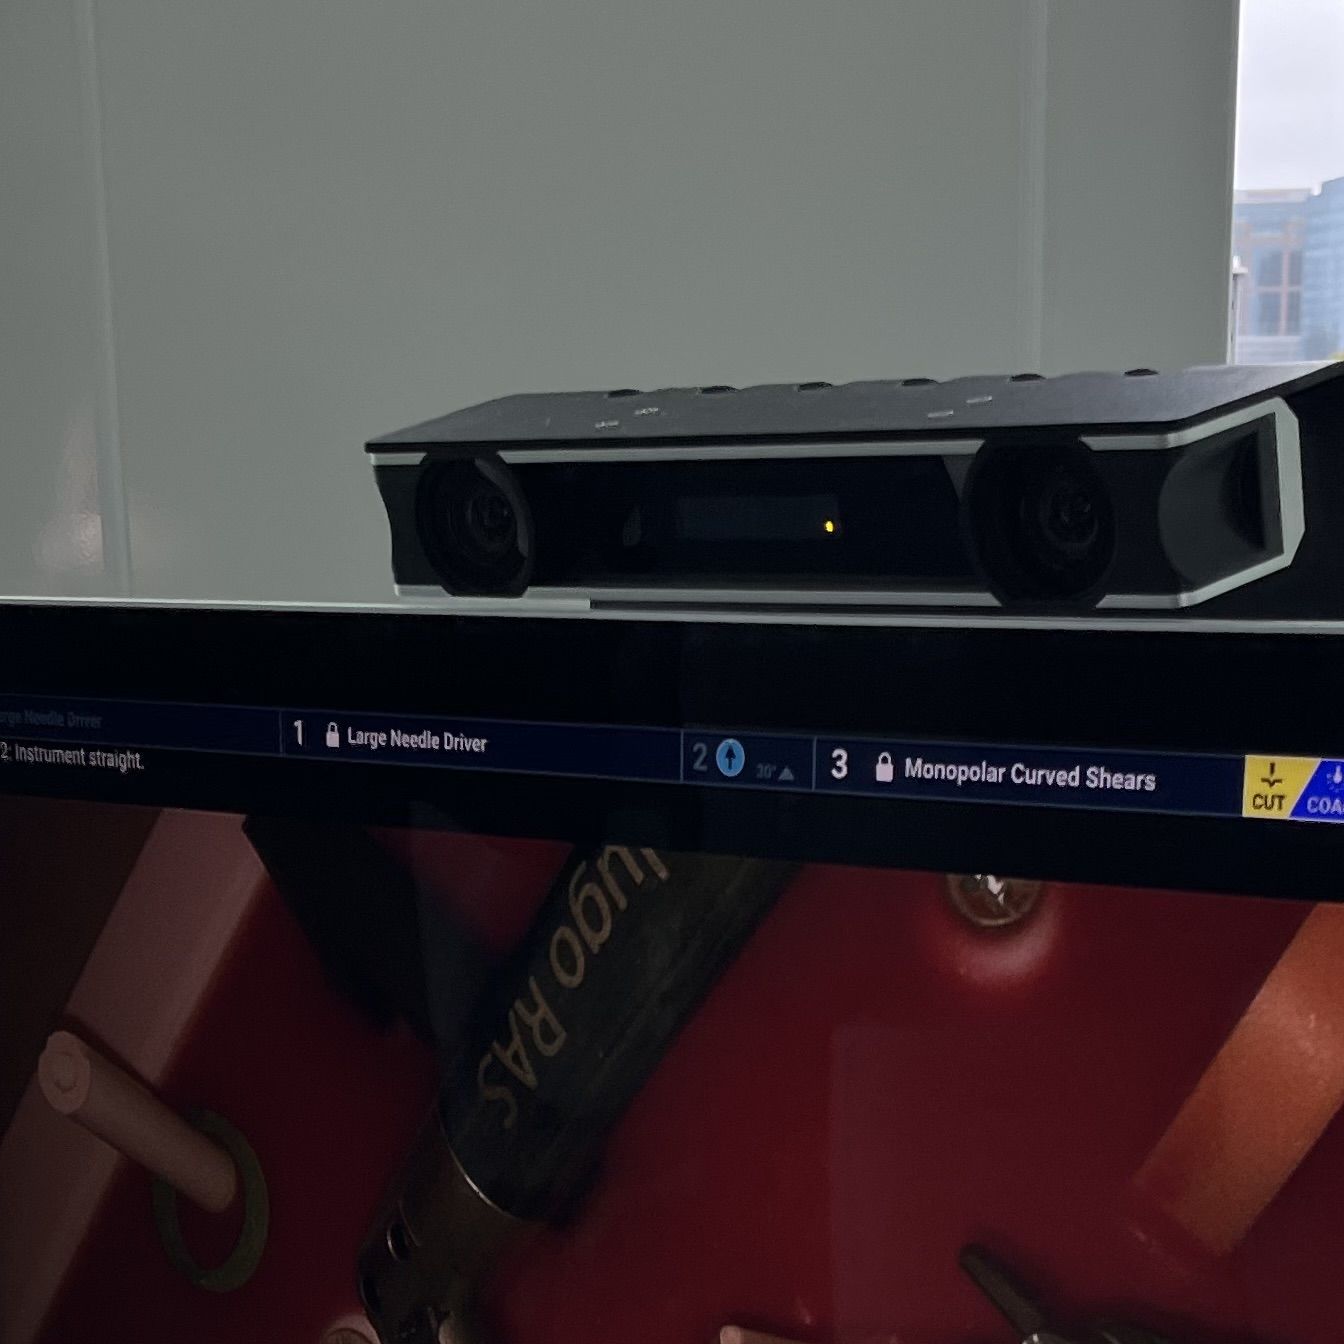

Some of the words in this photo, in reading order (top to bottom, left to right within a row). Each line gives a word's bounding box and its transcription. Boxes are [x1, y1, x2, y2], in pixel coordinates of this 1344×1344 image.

[293, 719, 303, 747] 1
[347, 726, 387, 750] Large
[390, 728, 440, 750] Needle
[443, 731, 488, 753] Driver
[15, 743, 87, 767] Instrument
[88, 748, 145, 775] straight.
[692, 742, 708, 771] 2
[831, 748, 849, 780] 3
[905, 757, 1007, 786] Monopolar
[1010, 763, 1081, 787] Curved
[1085, 766, 1157, 792] Shears
[1252, 794, 1286, 812] CUT
[477, 975, 567, 1129] RAS
